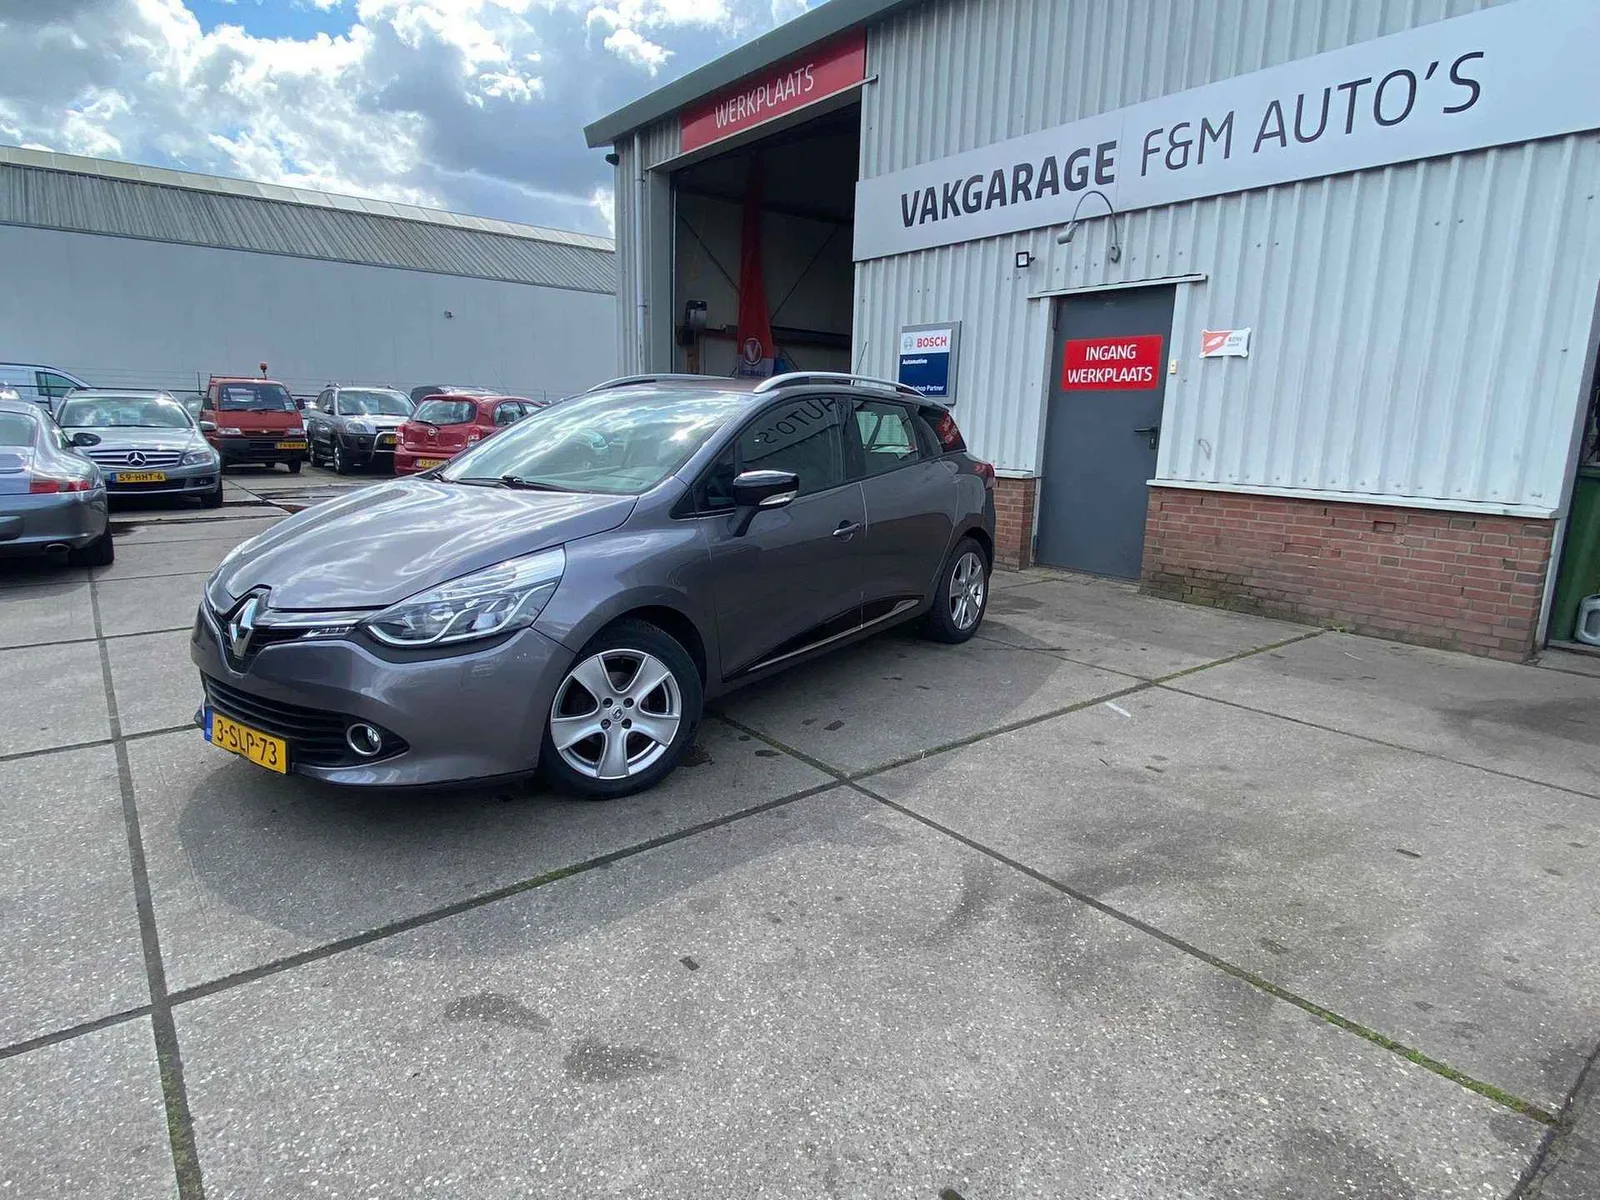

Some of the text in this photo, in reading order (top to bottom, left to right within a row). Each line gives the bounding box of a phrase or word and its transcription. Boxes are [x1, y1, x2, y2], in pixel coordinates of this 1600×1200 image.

[715, 63, 814, 129] WERKPLAATS
[900, 51, 1485, 228] VAKGARAGE F&M AUTO'S
[916, 336, 947, 348] BOSCH
[1085, 344, 1137, 361] INGANG
[1067, 367, 1153, 384] WERKPLAATS
[216, 719, 277, 766] 3-SLP-73
